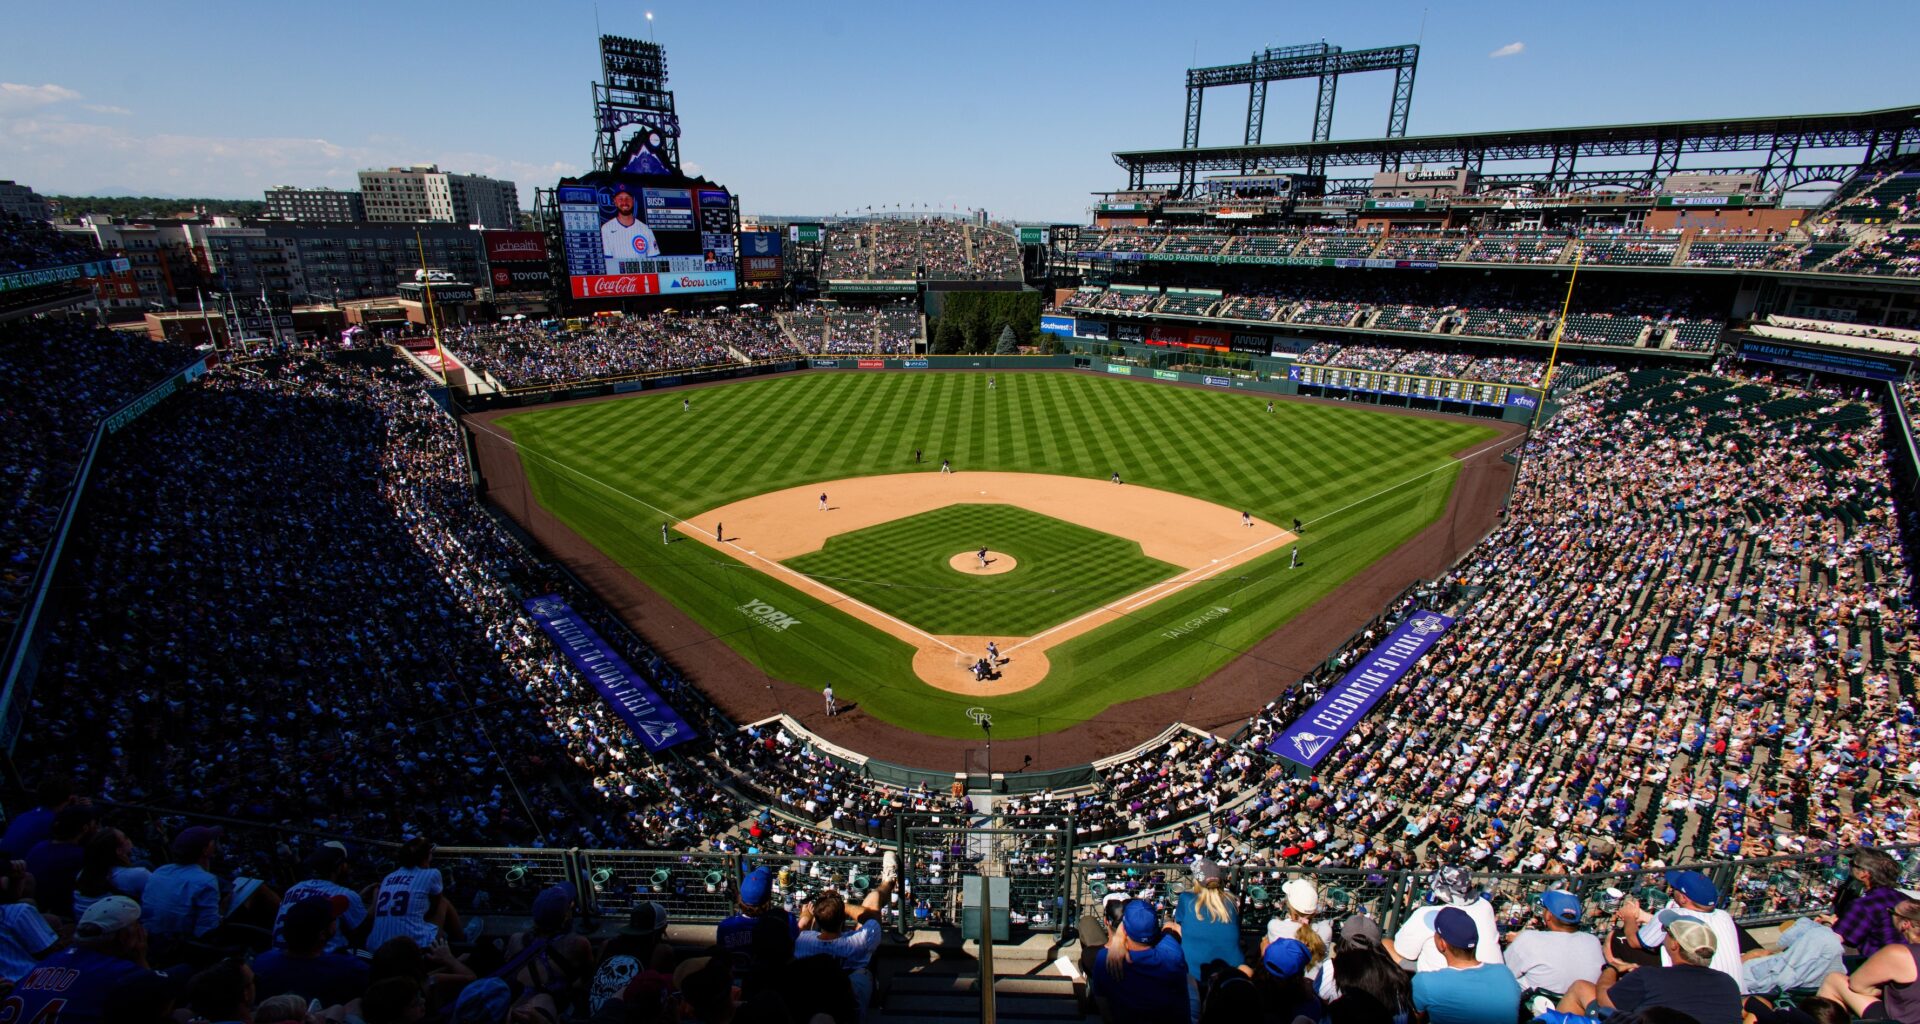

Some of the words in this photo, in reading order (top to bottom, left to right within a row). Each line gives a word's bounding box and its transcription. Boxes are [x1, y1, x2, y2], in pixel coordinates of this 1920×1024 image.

[646, 197, 665, 207] BUSCH
[1693, 197, 1724, 205] DECOY
[495, 240, 538, 251] uchealth
[751, 258, 776, 269] KING
[1175, 254, 1209, 262] PARTNER
[1240, 256, 1285, 265] COLORADO
[6, 275, 21, 288] THE
[21, 270, 57, 286] COLORADO
[57, 266, 81, 281] ROCKIES
[513, 271, 550, 280] TOYOTA
[594, 275, 637, 294] Coca-Cola
[680, 276, 705, 288] Coors
[705, 278, 727, 287] LIGHT
[438, 291, 473, 300] TUNDRA
[1041, 321, 1069, 331] Southwest
[1117, 325, 1133, 333] Bank
[1134, 325, 1141, 333] of
[1117, 332, 1145, 342] Colorado
[1193, 335, 1224, 346] STIHL
[1743, 343, 1758, 351] WIN
[1760, 345, 1790, 356] REALITY
[1108, 366, 1131, 375] bet365
[1513, 396, 1536, 408] xfinity
[743, 598, 802, 630] YORK
[550, 617, 594, 650] WELCOME
[1384, 633, 1425, 660] YEARS
[580, 649, 605, 662] TO
[1373, 657, 1401, 672] 30
[590, 661, 630, 689] COORS
[615, 687, 656, 717] FIELD
[1312, 668, 1390, 731] CELEBRATING
[386, 875, 415, 887] SINCE
[376, 890, 410, 917] 23
[22, 966, 80, 992] WOOD
